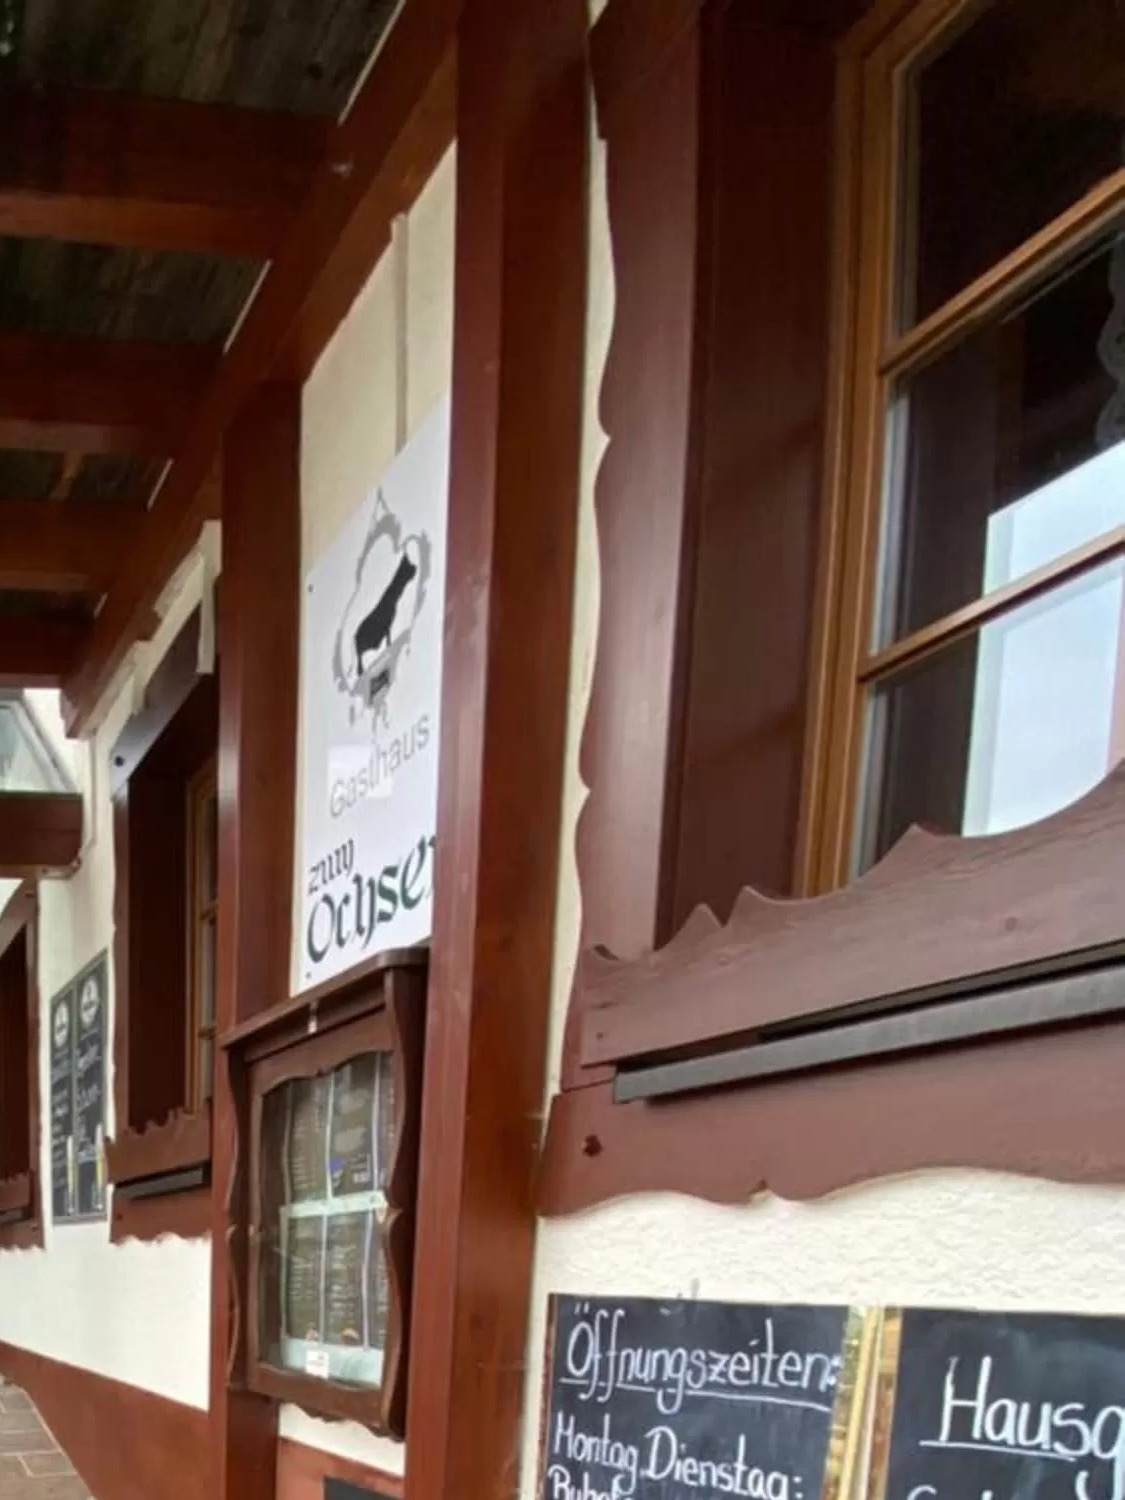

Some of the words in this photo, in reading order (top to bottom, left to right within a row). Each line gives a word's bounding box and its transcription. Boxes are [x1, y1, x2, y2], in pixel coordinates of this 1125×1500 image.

[330, 715, 430, 818] Gasthaus
[307, 835, 436, 963] Ochse
[565, 1302, 840, 1415] Öffnungszeiten:
